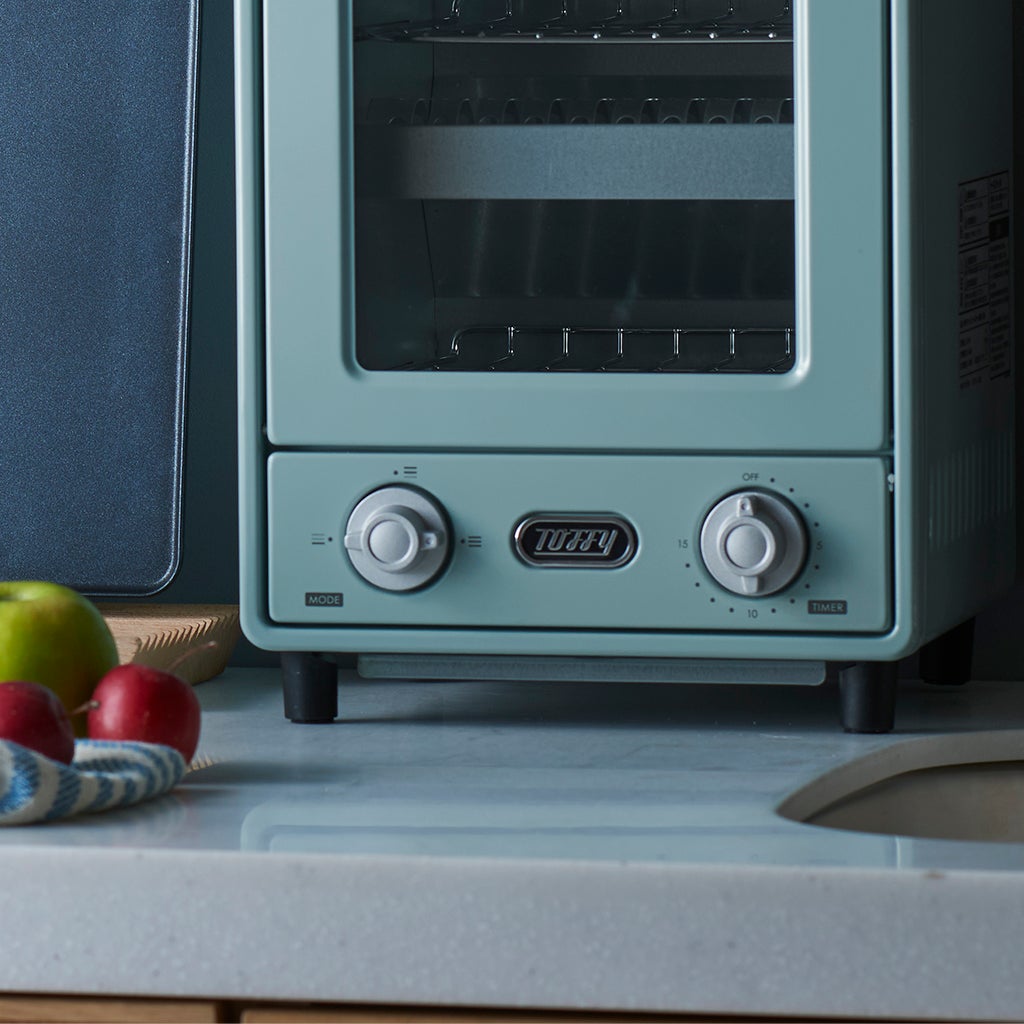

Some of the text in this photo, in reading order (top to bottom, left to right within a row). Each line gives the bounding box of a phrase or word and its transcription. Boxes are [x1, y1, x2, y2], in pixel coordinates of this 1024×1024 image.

[742, 472, 760, 482] OFF
[678, 539, 688, 549] 15
[816, 540, 823, 551] 5
[308, 595, 340, 605] MODE
[811, 602, 844, 613] TIMER
[747, 609, 758, 619] 10
